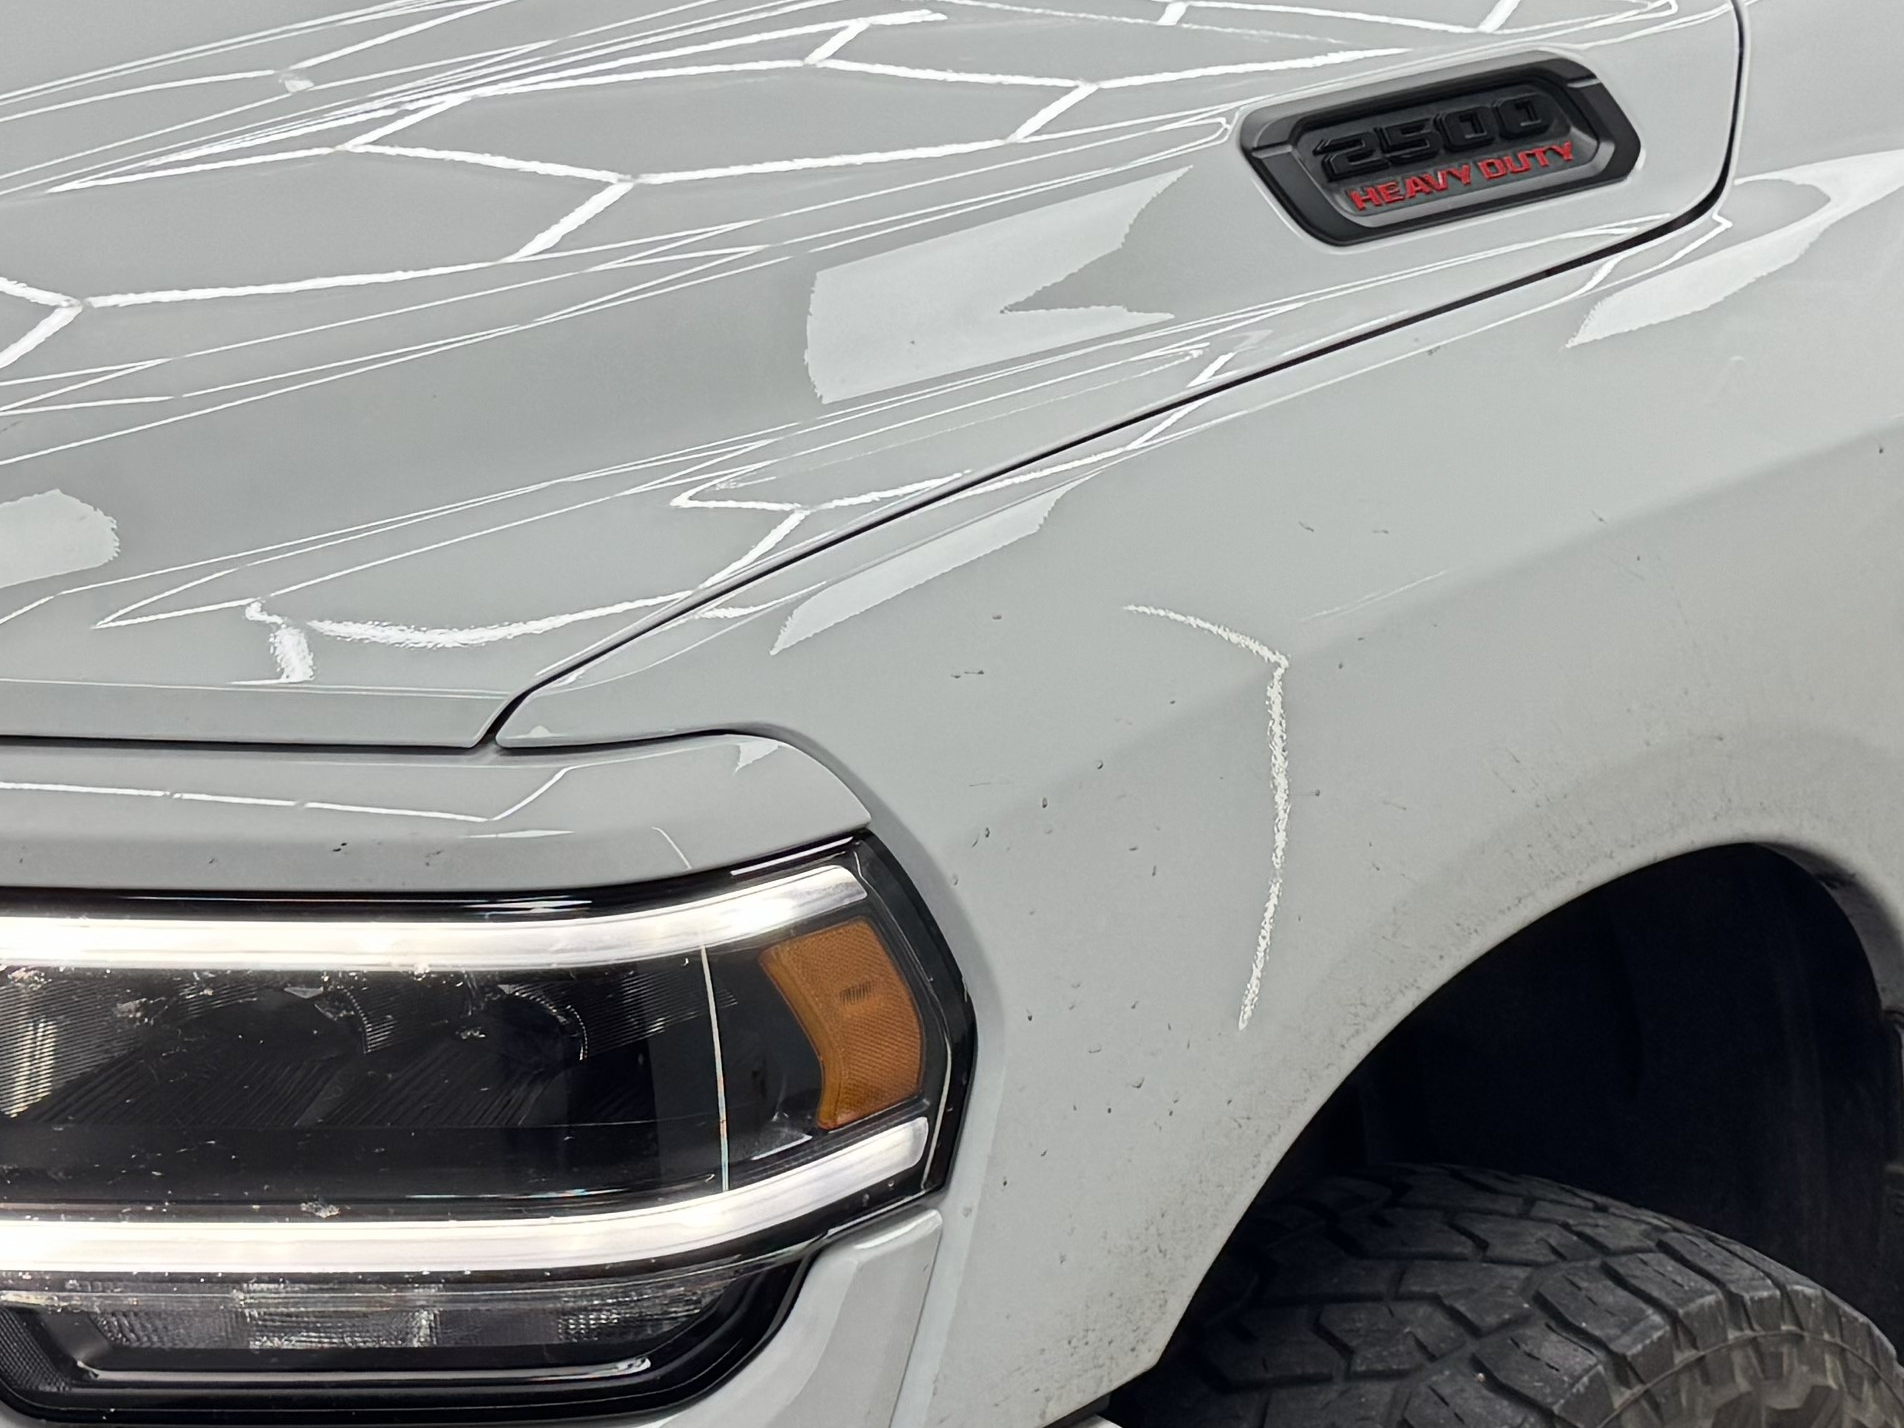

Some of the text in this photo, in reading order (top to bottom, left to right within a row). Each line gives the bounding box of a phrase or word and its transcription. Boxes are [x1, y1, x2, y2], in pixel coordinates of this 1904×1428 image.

[1313, 91, 1557, 181] 2500
[1348, 141, 1574, 210] HEAVY DUTY
